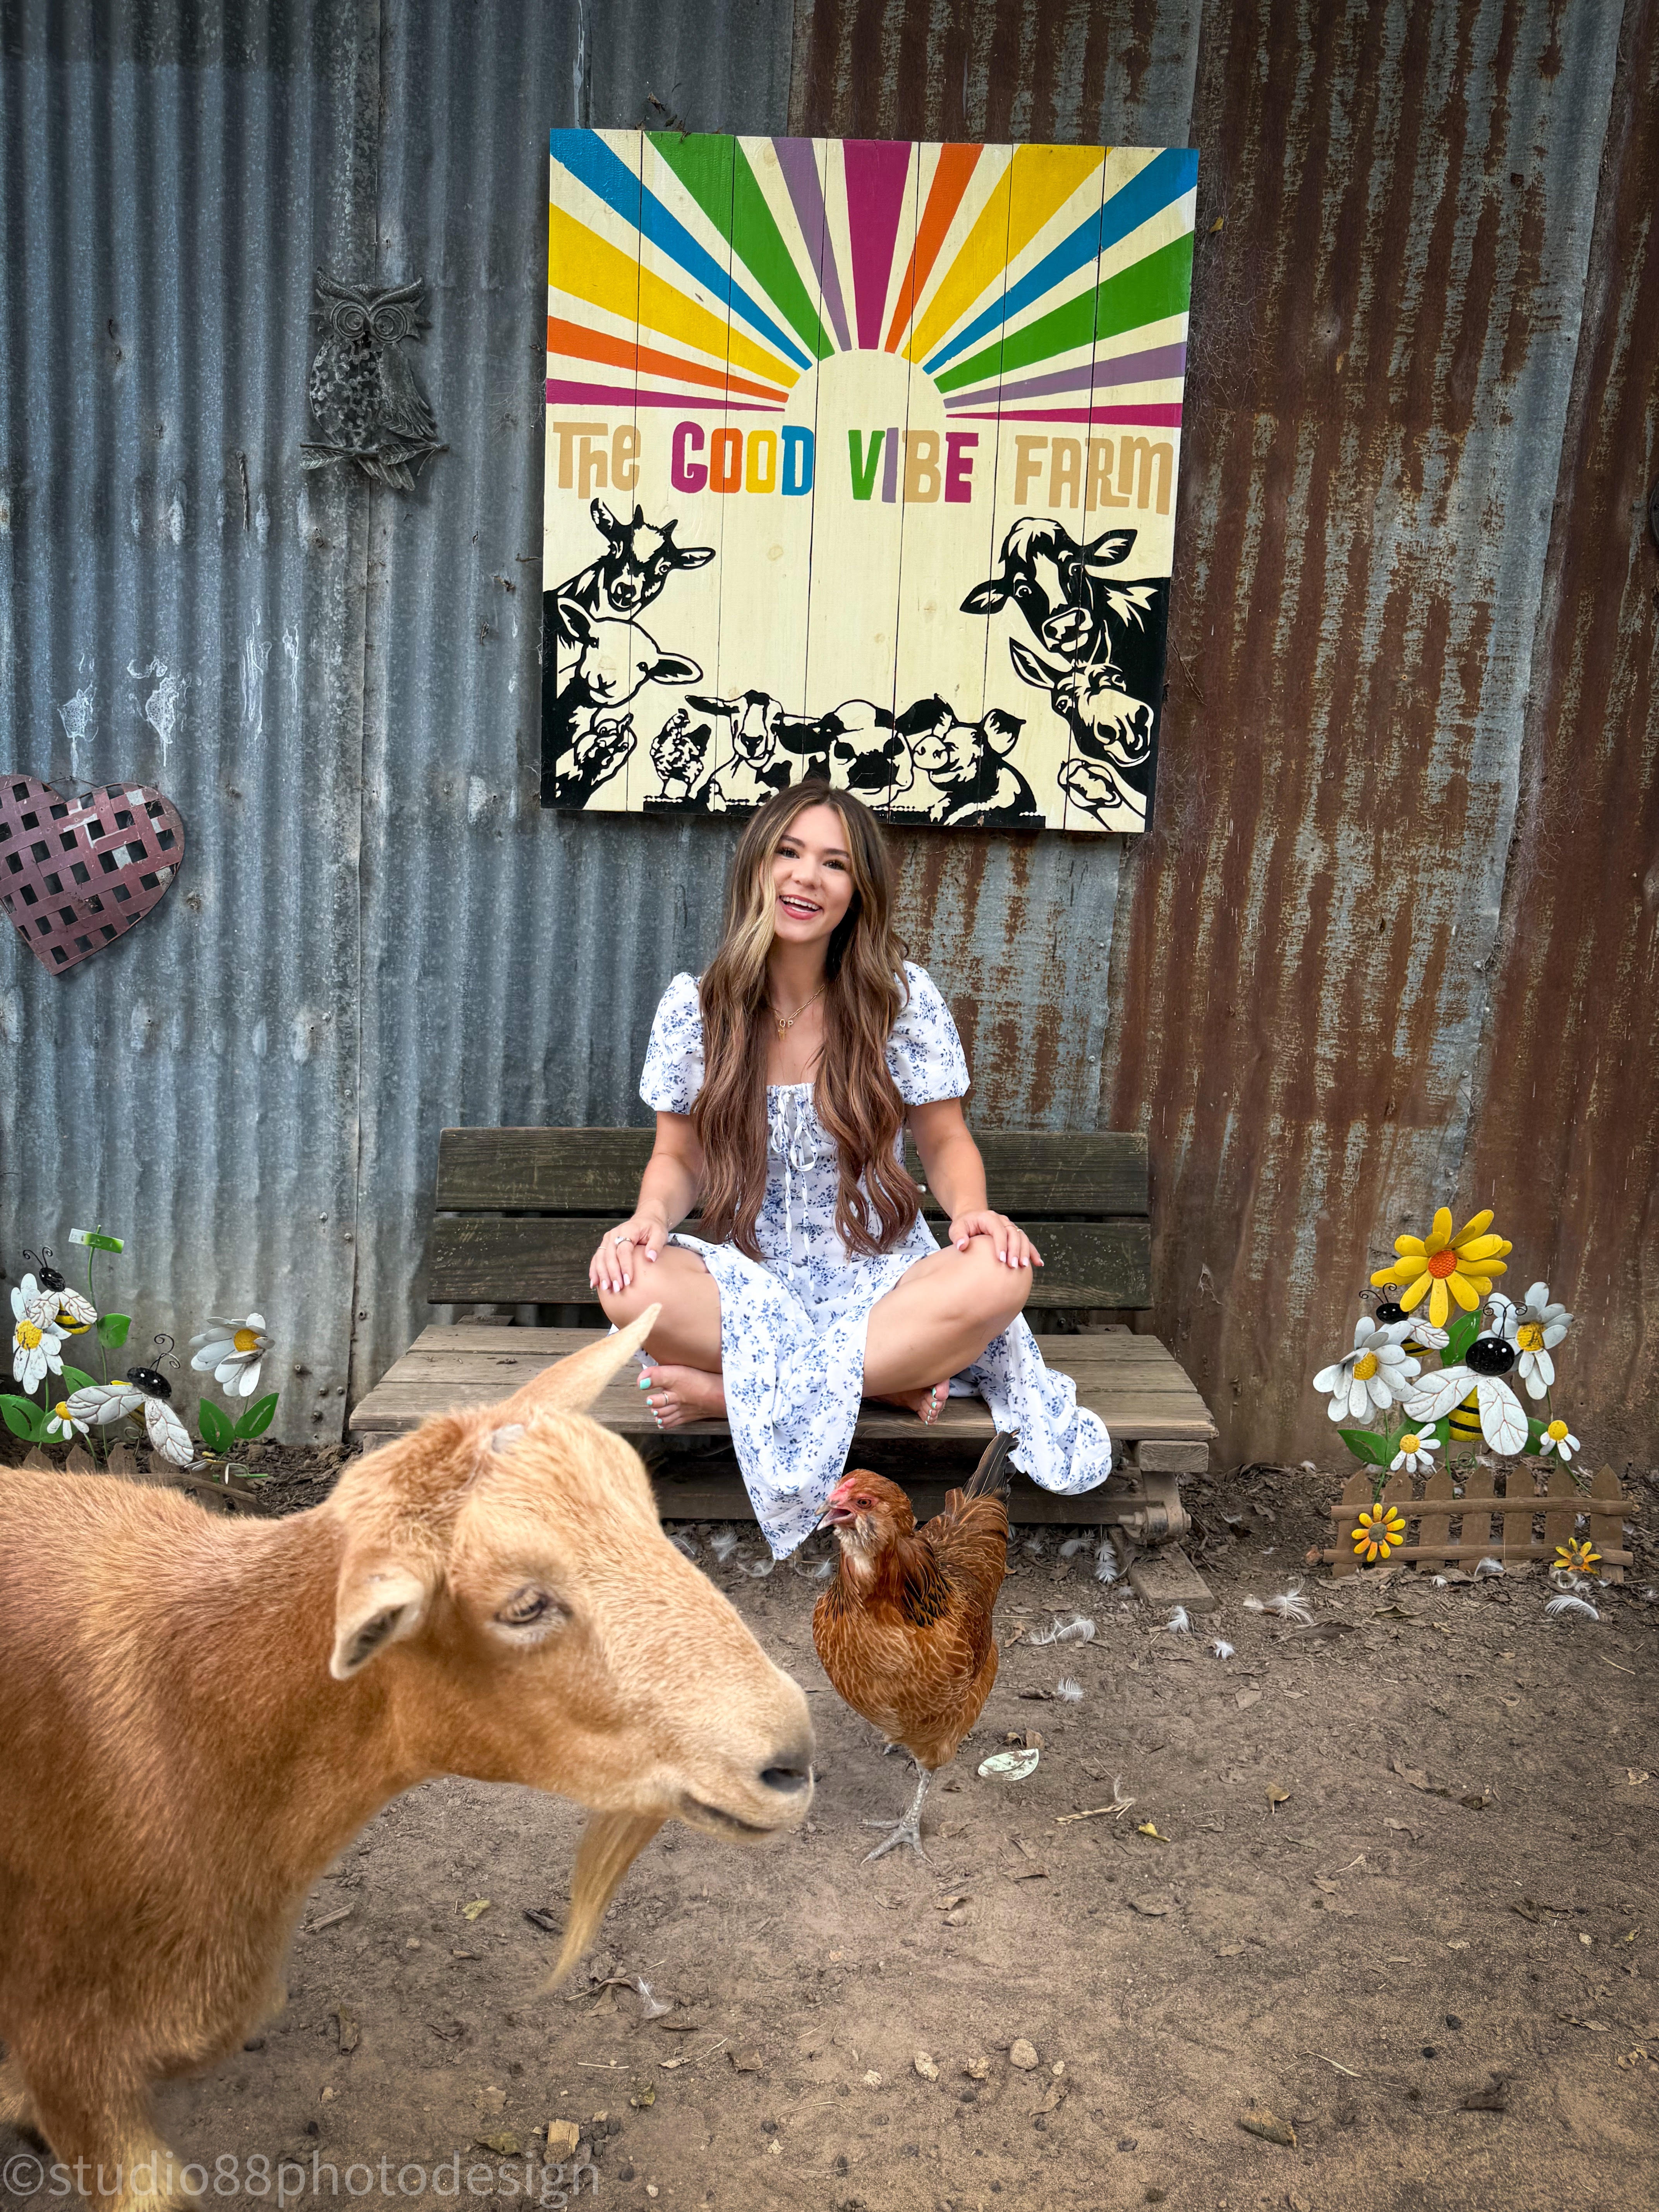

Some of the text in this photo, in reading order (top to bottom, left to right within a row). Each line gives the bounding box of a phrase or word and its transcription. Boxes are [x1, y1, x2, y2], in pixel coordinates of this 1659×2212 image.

[553, 421, 641, 500] The
[671, 421, 814, 496] GOOD
[848, 427, 979, 503] VIBE
